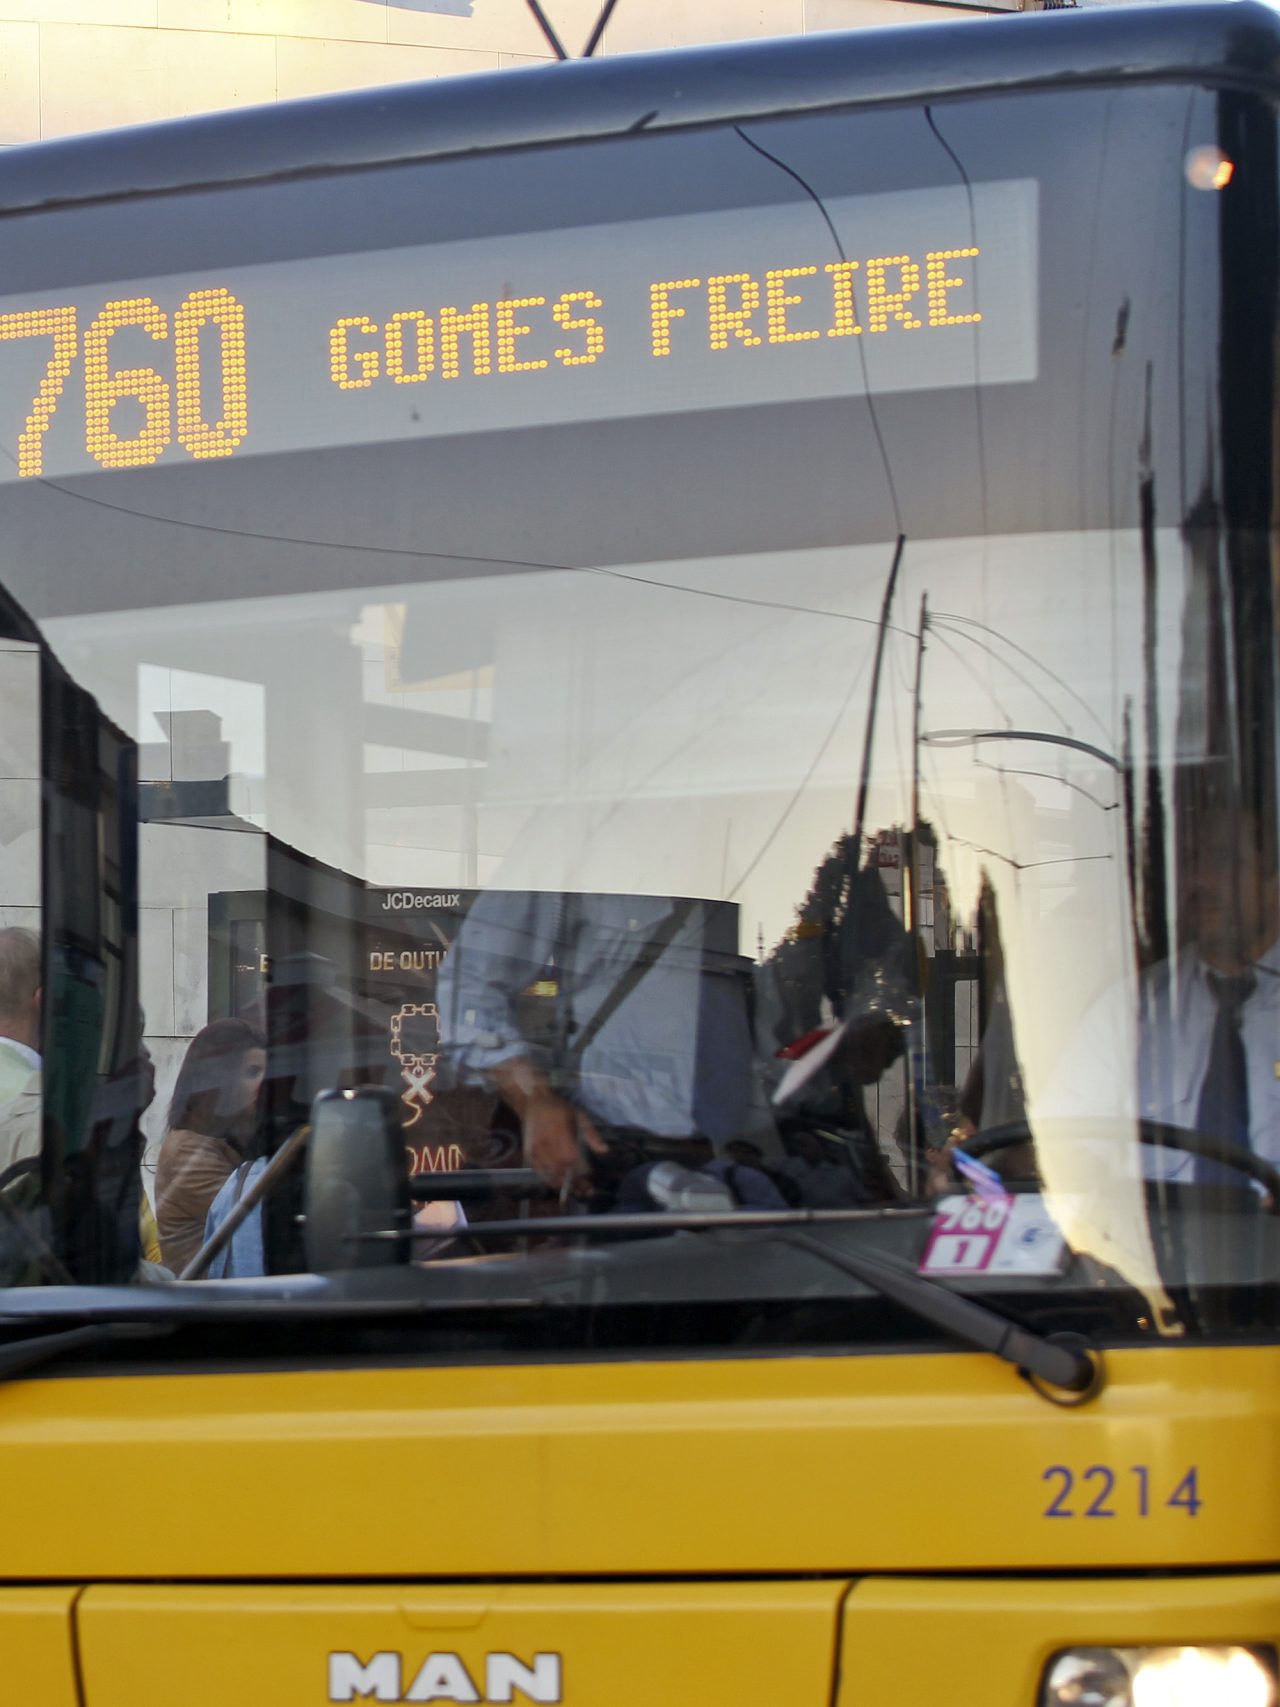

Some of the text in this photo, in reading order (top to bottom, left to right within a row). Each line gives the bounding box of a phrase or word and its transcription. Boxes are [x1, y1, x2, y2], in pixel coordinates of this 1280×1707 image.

[329, 291, 605, 390] GOMES
[650, 247, 983, 356] FREIRE
[382, 892, 460, 910] JCDecaux
[369, 951, 395, 971] DE
[936, 1199, 1008, 1231] 760
[1041, 1464, 1204, 1518] 2214
[328, 1650, 562, 1704] MAN
